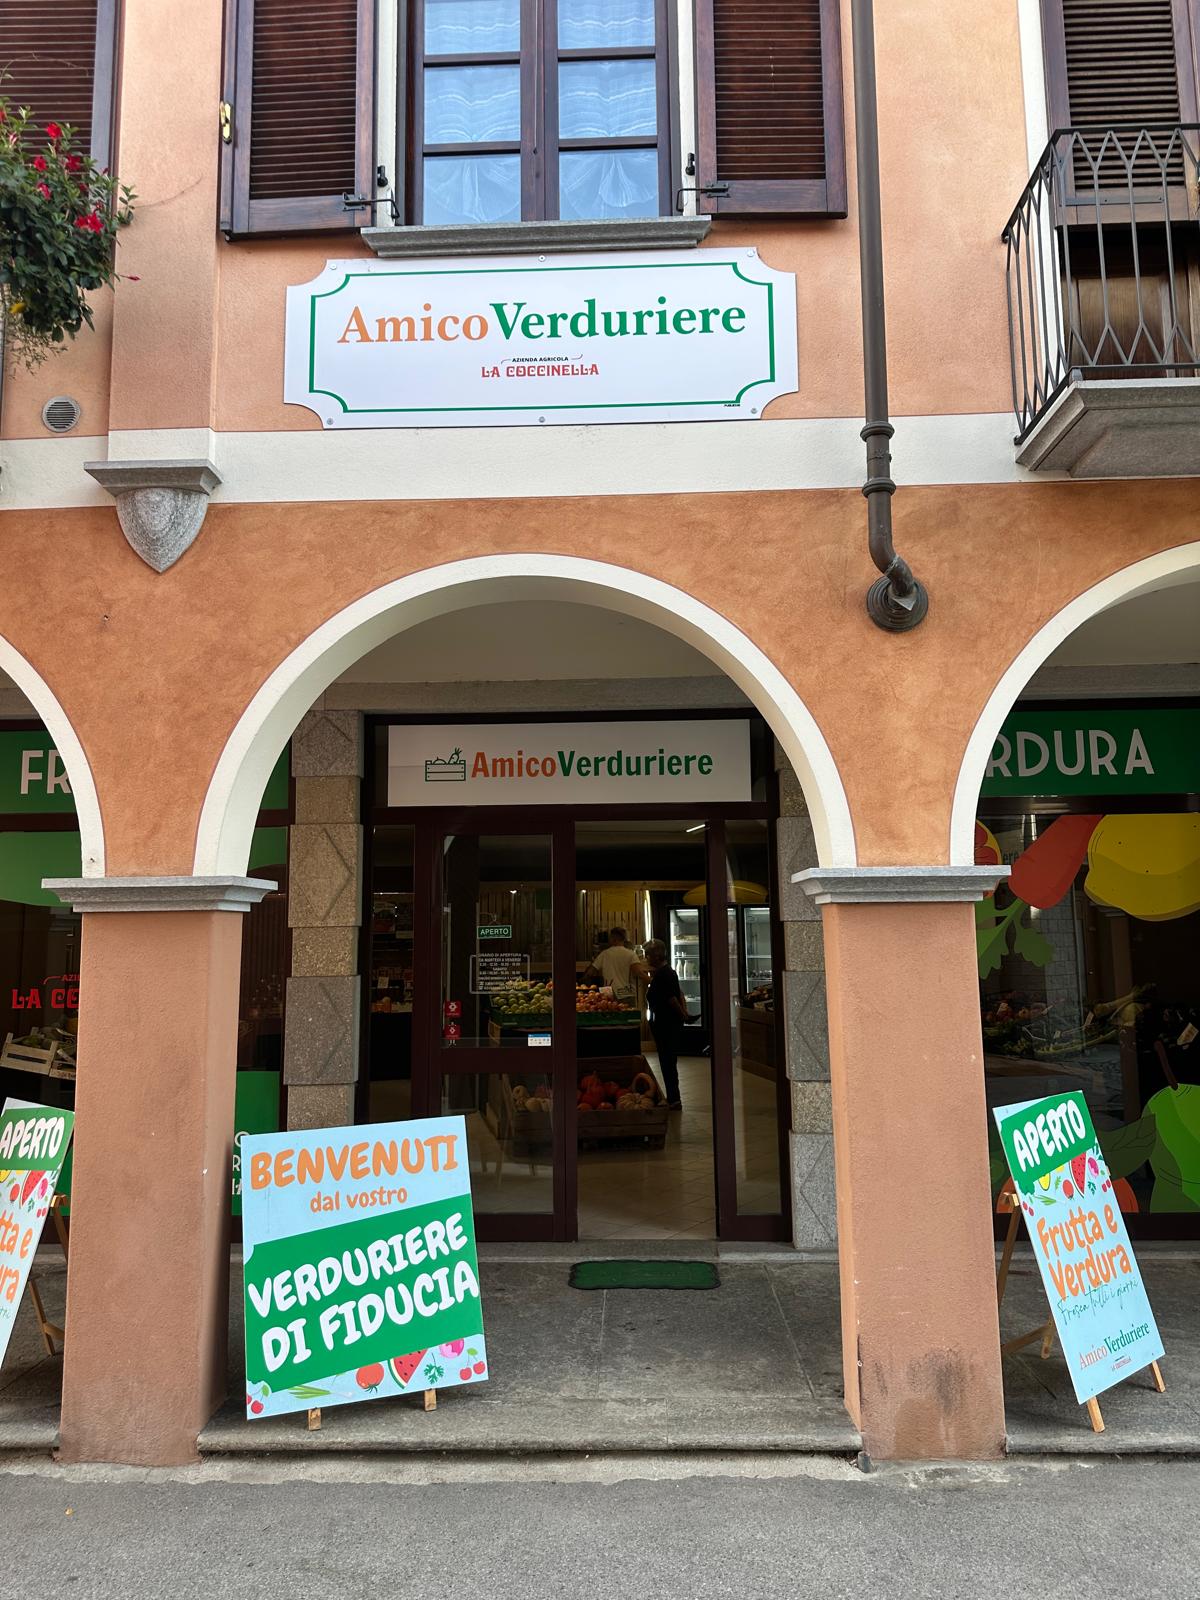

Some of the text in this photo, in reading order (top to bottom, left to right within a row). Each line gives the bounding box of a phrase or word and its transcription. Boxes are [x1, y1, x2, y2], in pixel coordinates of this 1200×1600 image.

[481, 363, 599, 378] LA COCCINELLA
[12, 988, 42, 1009] LA
[0, 1116, 65, 1160] APERTO
[250, 1135, 458, 1191] BENVENUTI
[1012, 1098, 1086, 1173] APERTO
[310, 1186, 408, 1213] dal vostro
[20, 1228, 33, 1259] e
[1036, 1203, 1118, 1261] Frutta e
[248, 1212, 468, 1318] VERDURIERE
[1048, 1243, 1132, 1302] Verdura
[261, 1260, 480, 1373] DI FIDUCIA
